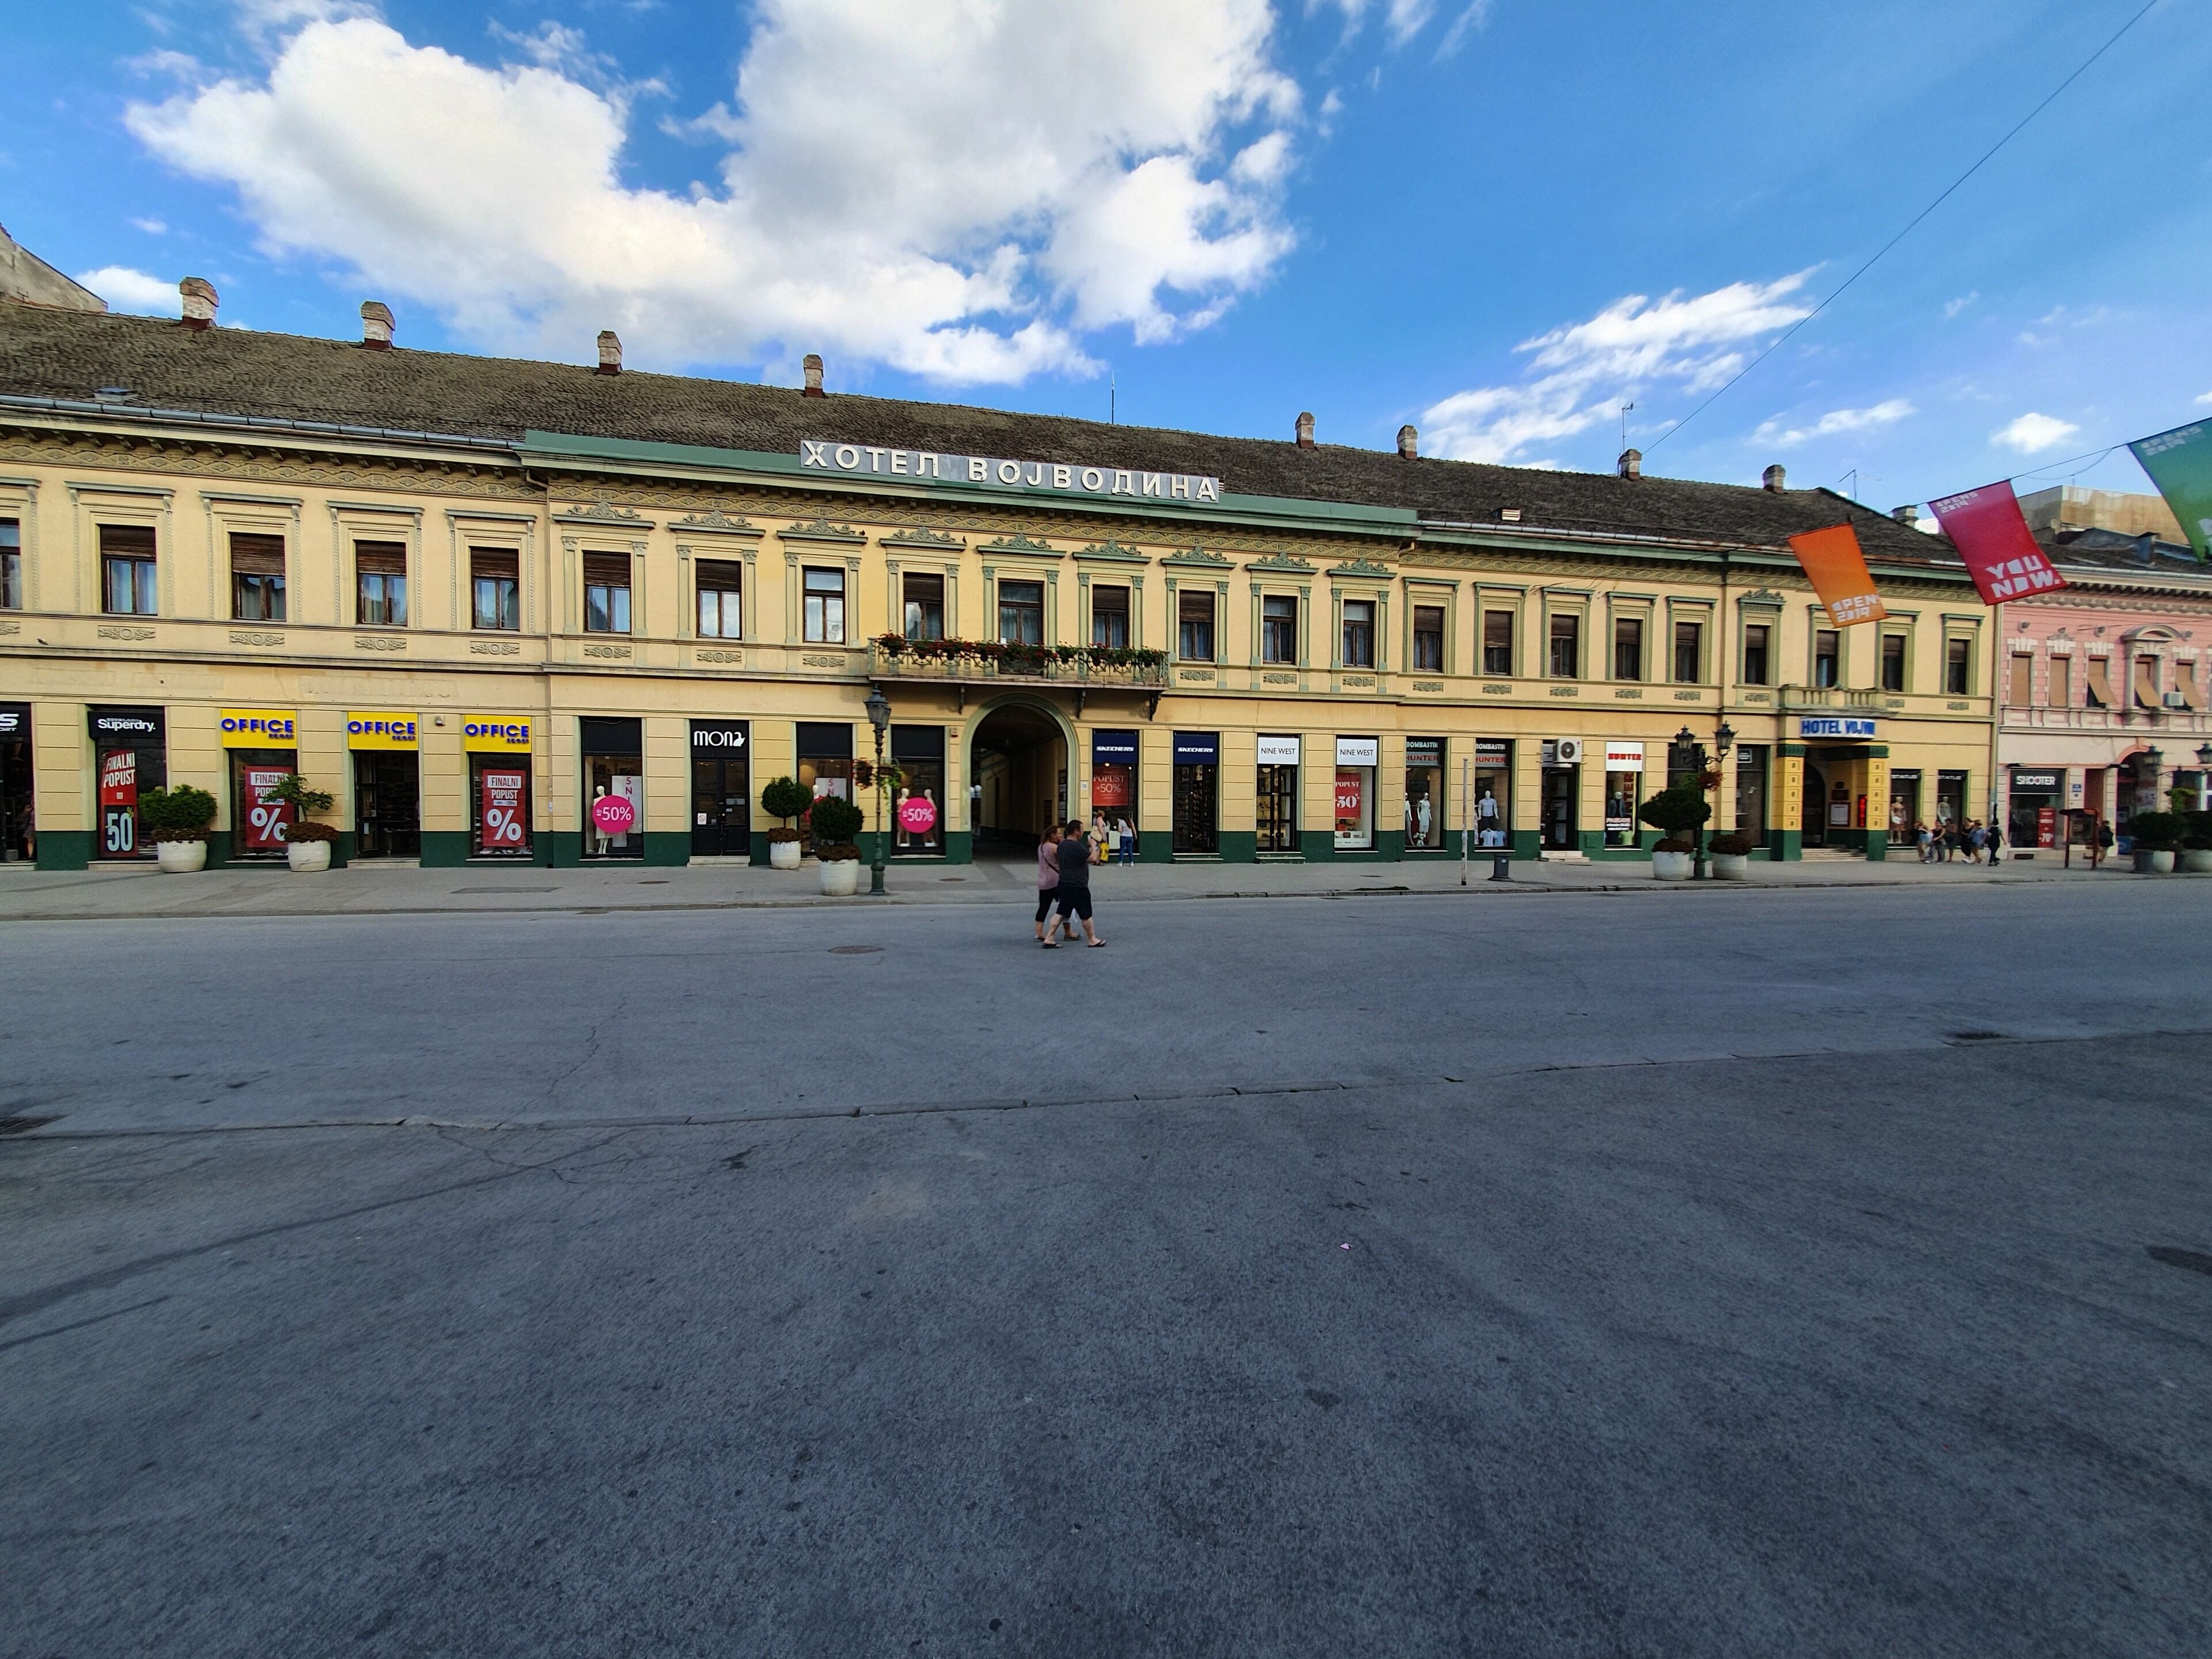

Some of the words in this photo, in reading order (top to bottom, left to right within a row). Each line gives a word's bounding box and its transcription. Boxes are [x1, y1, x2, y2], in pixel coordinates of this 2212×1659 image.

[804, 441, 939, 477] ХОТЕЛ
[968, 458, 1217, 501] ВОЈВОДИНА
[1985, 555, 2043, 579] YOU
[1991, 570, 2060, 598] NOW.
[221, 718, 294, 733] OFFICE
[348, 721, 416, 734] OFFICE
[465, 724, 529, 737] OFFICE
[1801, 720, 1842, 734] HOTEL
[106, 752, 135, 772] FINALNI
[103, 770, 135, 788] POPUST
[491, 778, 518, 786] FINALNI
[2016, 776, 2055, 786] SHOOTER
[491, 790, 518, 799] POPUST
[1097, 783, 1121, 793] -50%
[597, 806, 631, 821] -50%
